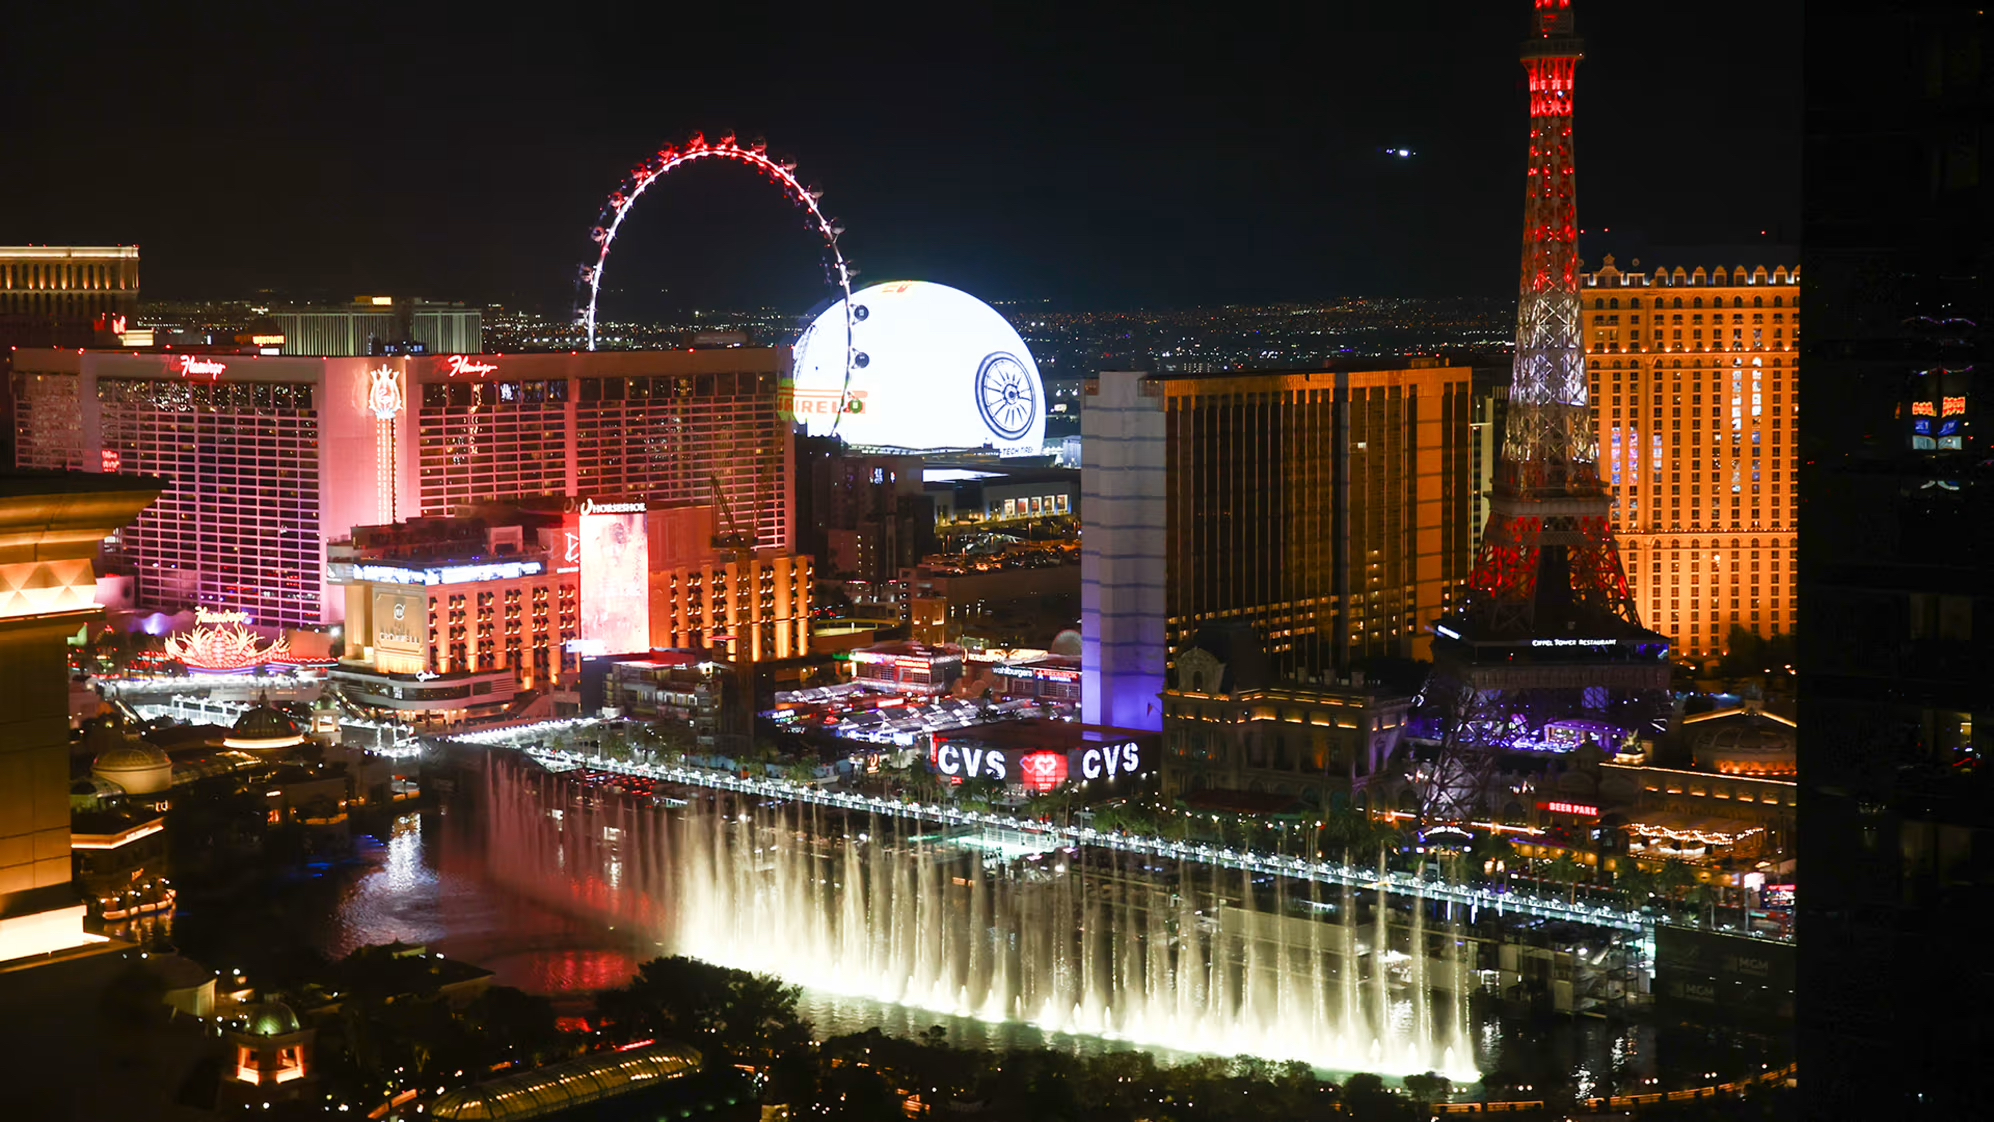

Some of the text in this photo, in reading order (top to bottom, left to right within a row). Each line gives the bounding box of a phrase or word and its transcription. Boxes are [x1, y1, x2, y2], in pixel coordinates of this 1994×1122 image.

[180, 355, 226, 380] Flamingo
[448, 355, 498, 377] Flamingo
[593, 503, 646, 513] HORSESHOE
[195, 605, 248, 626] Flamingo
[992, 667, 1033, 678] wahlburgers
[938, 744, 1006, 779] CVS
[1082, 742, 1139, 779] CVS
[1549, 802, 1597, 815] BEER PARK
